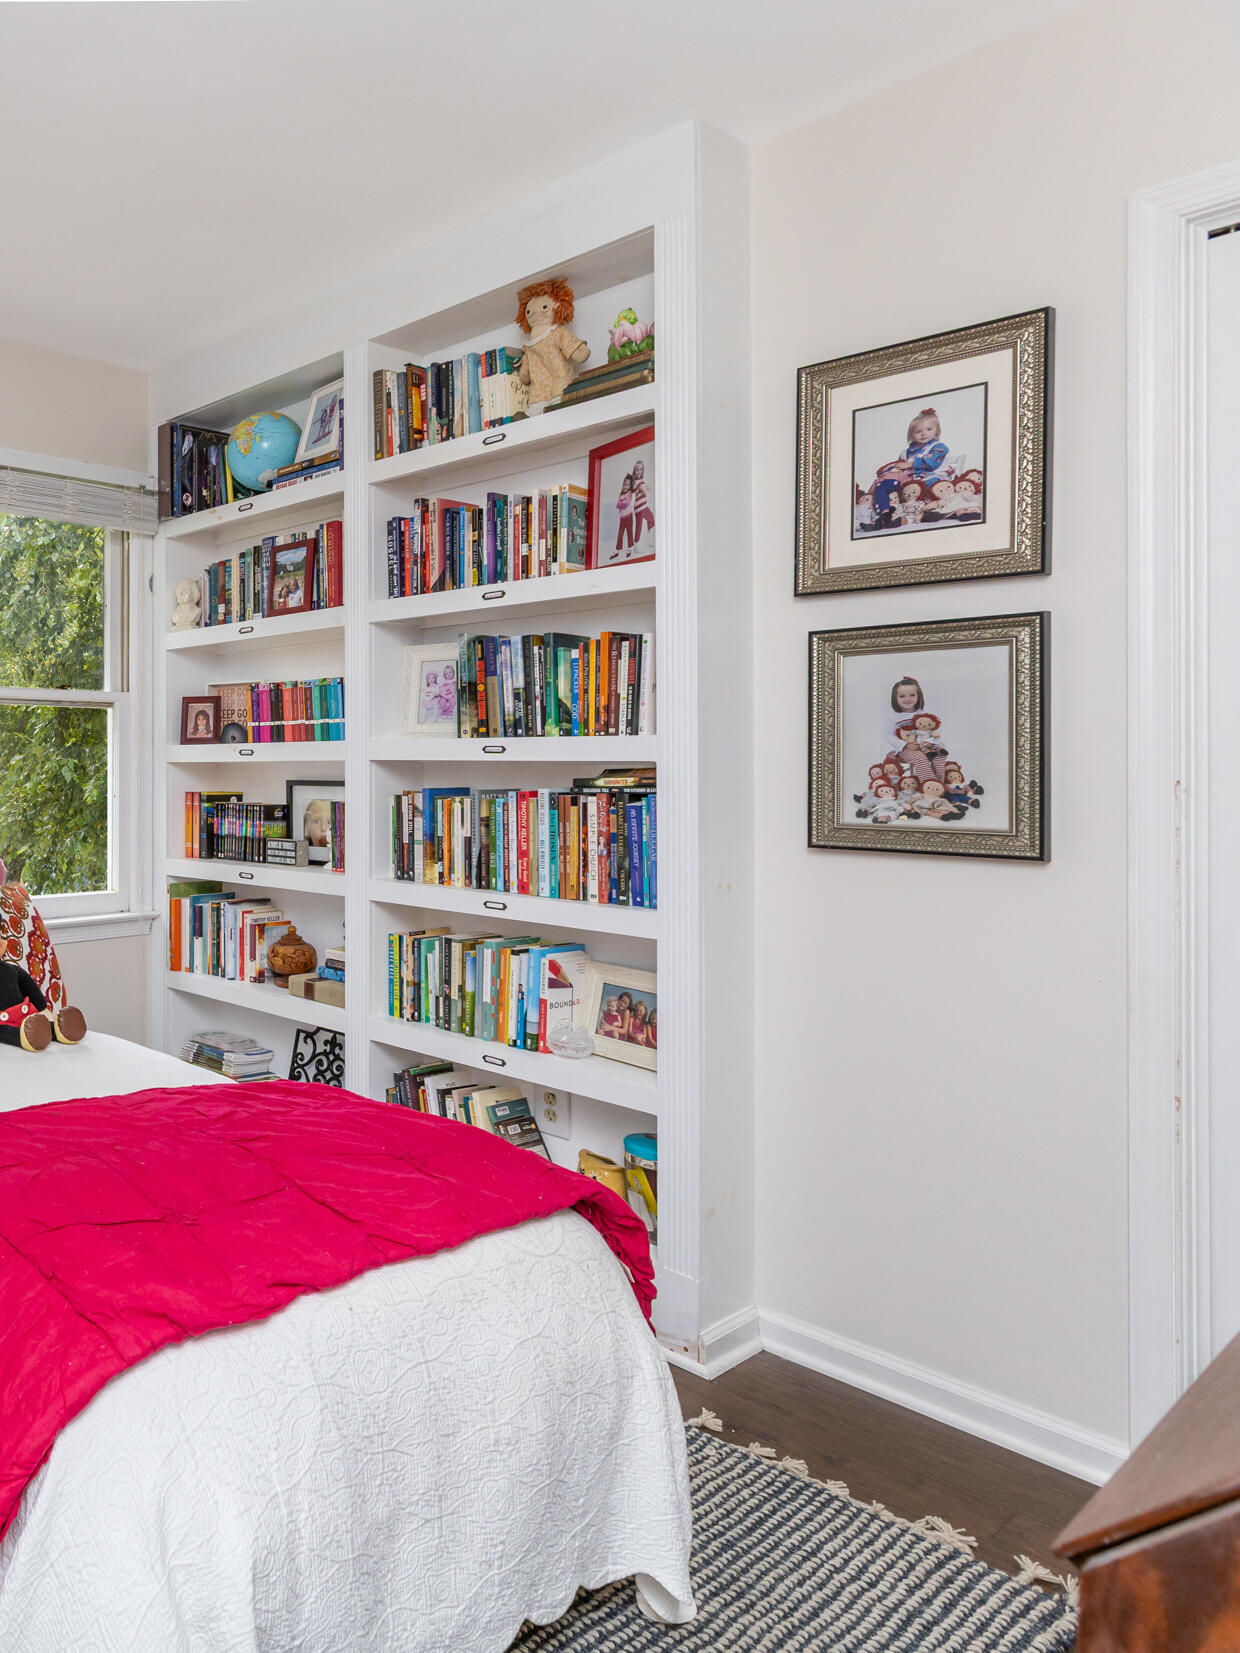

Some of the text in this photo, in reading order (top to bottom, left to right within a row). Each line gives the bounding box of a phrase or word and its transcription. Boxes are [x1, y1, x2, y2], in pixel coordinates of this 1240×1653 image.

[387, 535, 395, 571] GOSPEL
[610, 651, 618, 690] RESOLUTION
[520, 800, 528, 828] TIMOTHY
[550, 824, 558, 861] CHOSEN
[632, 842, 640, 867] JOURNEY
[250, 917, 266, 925] TIMOTHY
